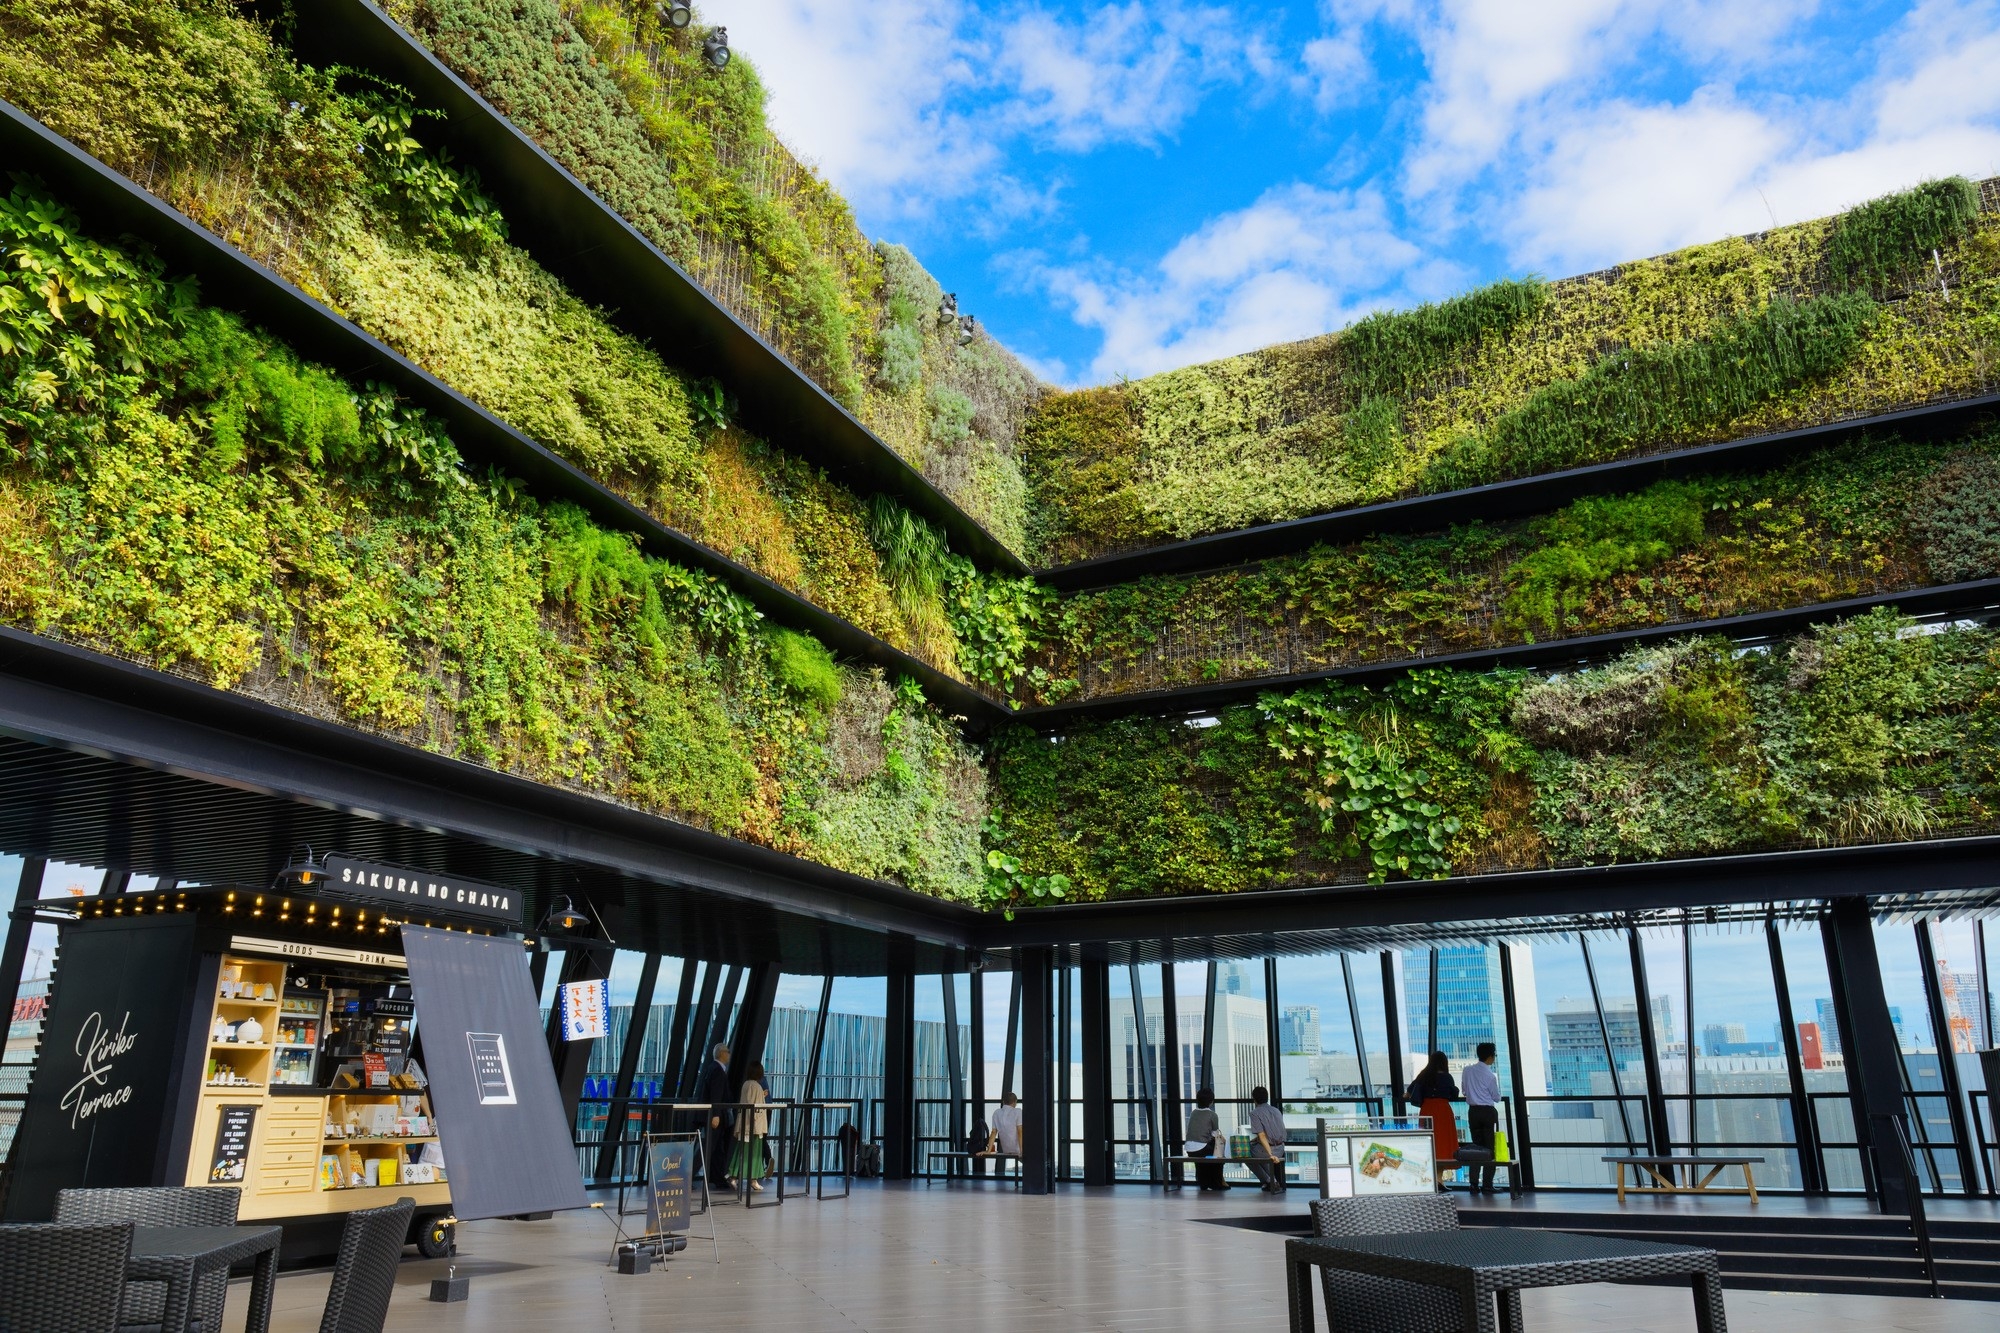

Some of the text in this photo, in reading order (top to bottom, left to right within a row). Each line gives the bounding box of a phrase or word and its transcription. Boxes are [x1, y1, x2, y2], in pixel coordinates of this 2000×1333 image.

[342, 868, 509, 911] SAKURA NO CHAYA
[282, 944, 313, 956] GOODS
[359, 953, 386, 965] DRINK
[380, 1003, 410, 1012] POPCORN
[75, 1011, 138, 1085] Kiriko
[60, 1064, 133, 1130] Terrace
[1330, 1140, 1338, 1152] R
[662, 1156, 682, 1172] Open!
[656, 1188, 684, 1198] SAKURA
